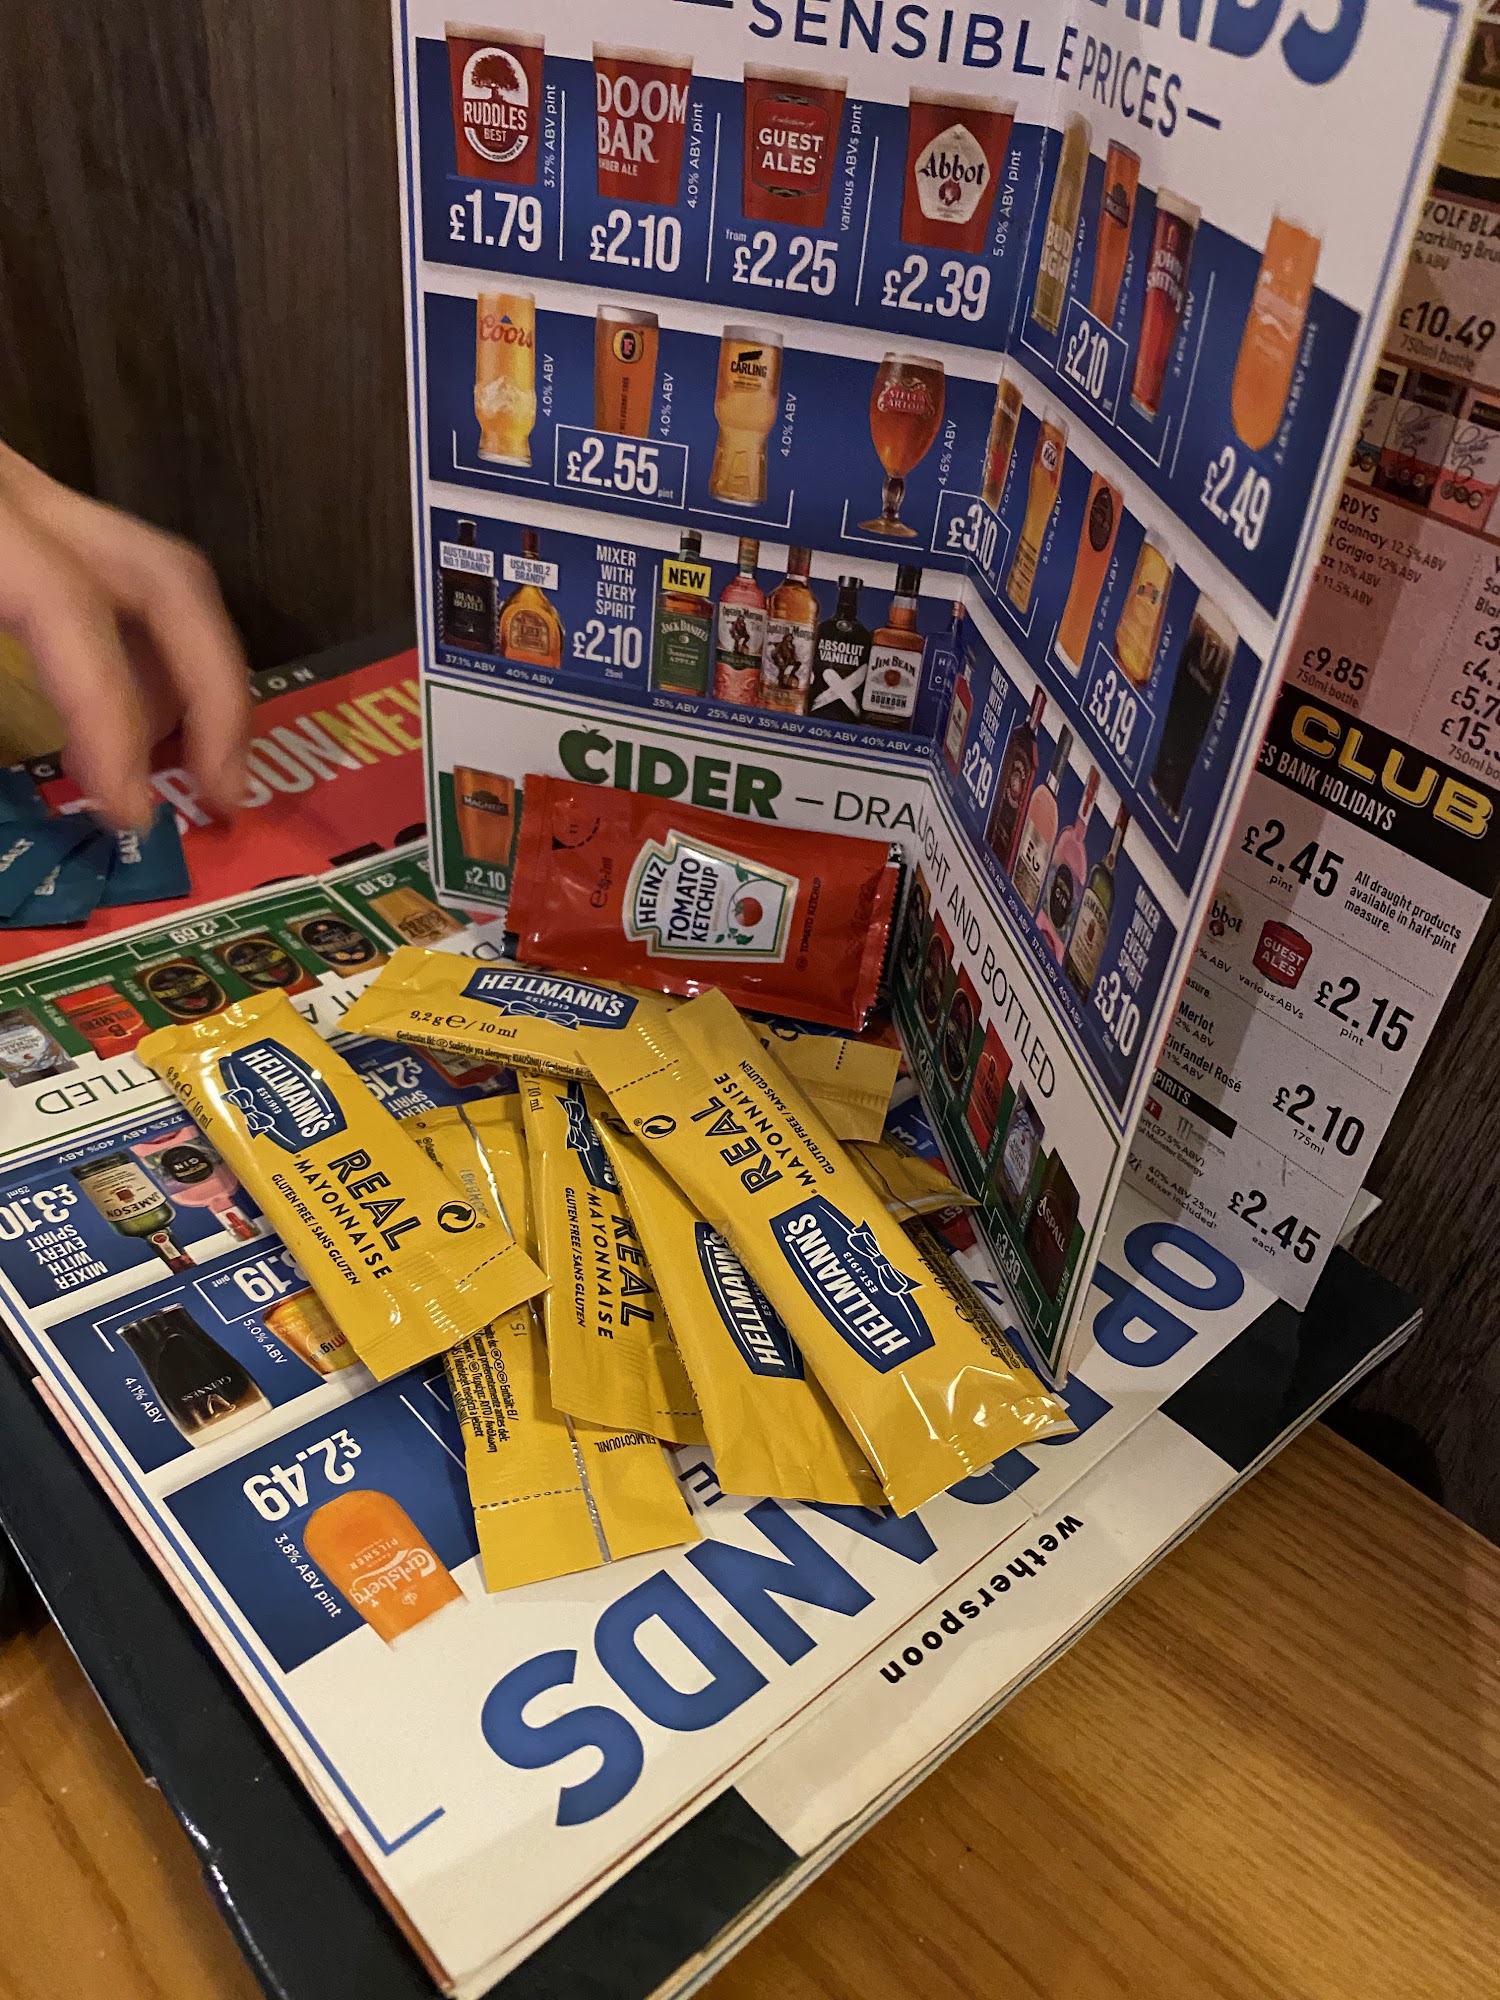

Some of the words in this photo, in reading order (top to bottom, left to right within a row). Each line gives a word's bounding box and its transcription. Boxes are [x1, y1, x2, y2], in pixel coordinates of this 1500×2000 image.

[748, 0, 1079, 83] SENSIBLE
[1078, 35, 1183, 138] PRICES
[546, 84, 557, 114] pint
[596, 72, 689, 124] DOOM
[463, 101, 527, 131] RUDDLES
[693, 102, 704, 133] pint
[851, 104, 863, 135] pint
[483, 129, 507, 143] BEST
[544, 118, 556, 152] ABV
[596, 116, 659, 164] BAR
[758, 127, 824, 153] GUEST
[689, 137, 701, 170] ABV
[760, 151, 817, 176] ALES
[843, 140, 858, 177] ABVs
[918, 151, 987, 186] Abbot
[1008, 150, 1022, 181] pint
[544, 156, 555, 188] 3.7%
[687, 173, 699, 208] 4.0%
[840, 180, 854, 231] various
[1001, 184, 1016, 218] ABV
[450, 189, 542, 252] £1.79
[725, 228, 747, 242] from
[589, 209, 682, 273] £2.10
[992, 220, 1009, 257] 5.0%
[732, 231, 839, 296] £2.25
[881, 254, 991, 321] £2.39
[479, 314, 533, 349] Coors
[1399, 301, 1496, 351] £10.49
[543, 354, 555, 383] ABV
[730, 361, 767, 379] CARLING
[1064, 320, 1109, 400] £2.10
[543, 386, 554, 417] 4.0%
[663, 373, 674, 401] ABV
[660, 406, 672, 436] 4.0%
[784, 393, 798, 423] ABV
[780, 424, 794, 457] 4.0%
[943, 420, 957, 451] ABV
[566, 437, 659, 495] £2.55
[938, 455, 952, 485] 4.6%
[1200, 446, 1272, 551] £2.49
[947, 504, 998, 571] £3.10
[1336, 536, 1375, 564] Grigio
[443, 545, 491, 564] AUSTRALIA'S
[460, 560, 490, 575] BRANDY
[510, 559, 531, 572] USA'S
[532, 564, 551, 576] NO.2
[596, 544, 637, 567] MIXER
[515, 571, 546, 586] BRANDY
[601, 563, 634, 584] WITH
[668, 567, 706, 589] NEW
[596, 581, 637, 603] EVERY
[595, 600, 637, 621] SPIRIT
[660, 620, 680, 634] JACK
[573, 619, 643, 669] £2.10
[818, 638, 864, 656] ABSOLUT
[819, 652, 860, 668] VANILIA
[473, 659, 496, 672] ABV
[506, 668, 529, 680] 40%
[531, 673, 554, 685] ABV
[871, 656, 890, 670] JIM
[891, 657, 916, 676] BEAM
[1296, 669, 1328, 692] 750ml
[1303, 647, 1368, 691] £9.85
[652, 698, 674, 710] 35%
[676, 702, 700, 714] ABV
[708, 708, 729, 720] 25%
[730, 712, 755, 725] ABV
[870, 693, 907, 708] BOURBON
[1088, 669, 1137, 755] £3.19
[758, 718, 780, 730] 35%
[781, 721, 805, 734] ABV
[808, 727, 832, 740] 40%
[834, 731, 858, 743] ABV
[861, 736, 885, 748] 40%
[887, 740, 912, 752] ABV
[963, 741, 994, 809] £2.19
[1291, 705, 1494, 840] CLUB
[1278, 750, 1321, 791] BANK
[1319, 774, 1397, 832] HOLIDAYS
[1241, 818, 1344, 898] £2.45
[638, 860, 668, 925] HEINZ
[1269, 874, 1294, 894] pint
[558, 725, 784, 820] CIDER
[833, 790, 951, 894] DRAUGHT
[947, 885, 981, 956] AND
[980, 944, 1056, 1099] BOTTLED
[666, 856, 702, 945] TOMATO
[688, 866, 720, 944] KETCHUP
[1355, 871, 1369, 884] All
[1368, 876, 1411, 909] draught
[1411, 902, 1462, 940] products
[1343, 899, 1391, 935] measure.
[1349, 885, 1396, 918] available
[1396, 909, 1407, 924] in
[1405, 915, 1458, 956] half-pint
[1260, 952, 1298, 979] ALES
[1263, 936, 1305, 967] GUEST
[478, 972, 625, 1018] HELLMANN'S
[525, 993, 570, 1011] EST.1913
[1238, 973, 1276, 1005] various
[1275, 996, 1305, 1020] ABVs
[478, 1021, 496, 1034] 10
[1093, 970, 1141, 1057] £3.10
[1178, 1000, 1215, 1035] Merlot
[1313, 975, 1415, 1053] £2.15
[1191, 1029, 1215, 1048] ABV
[1338, 1026, 1365, 1047] pint
[737, 1059, 769, 1093] GLUTEN
[1180, 1062, 1204, 1081] ABV
[1213, 1065, 1243, 1094] Rosé
[240, 1045, 332, 1139] HELLMANN'S
[256, 1085, 285, 1116] EST.1913
[388, 1089, 428, 1113] SPIRIT
[763, 1088, 787, 1113] SANS
[713, 1072, 817, 1187] MAYONNAISE
[786, 1116, 809, 1145] FREE
[1272, 1084, 1366, 1157] £2.10
[57, 1146, 84, 1163] ABV
[87, 1138, 115, 1153] 40%
[690, 1094, 784, 1195] REAL
[1292, 1128, 1325, 1156] 175ml
[173, 1158, 201, 1172] GIN
[802, 1141, 836, 1176] GLUTEN
[106, 1191, 162, 1217] JAMESON
[328, 1147, 422, 1252] REAL
[565, 1187, 579, 1223] GLUTEN
[270, 1172, 302, 1206] GLUTEN
[294, 1202, 315, 1229] FREE
[311, 1224, 336, 1252] SANS
[328, 1246, 362, 1286] GLUTEN
[292, 1157, 393, 1280] MAYONNAISE
[1037, 1196, 1066, 1253] ASPALL
[1227, 1189, 1322, 1264] £2.45
[29, 1223, 79, 1254] SPIRIT
[38, 1239, 88, 1265] EVERY
[570, 1224, 581, 1248] FREE
[1252, 1235, 1277, 1257] each
[47, 1250, 93, 1274] WITH
[55, 1259, 109, 1292] MIXER
[573, 1254, 583, 1281] SANS
[587, 1192, 613, 1339] MAYONNAISE
[610, 1214, 655, 1327] REAL
[842, 1252, 879, 1294] EST.1913
[211, 1274, 230, 1288] pint
[783, 1211, 912, 1357] HELLMANN'S
[575, 1284, 586, 1327] GLUTEN
[697, 1232, 787, 1371] HELLMANN'S
[242, 1318, 268, 1344] 5.0%
[262, 1340, 288, 1365] ABV
[125, 1375, 145, 1401] 4.1%
[139, 1399, 165, 1425] ABV
[181, 1375, 232, 1403] GUINNESS
[242, 1428, 363, 1523] £2.49
[349, 1537, 399, 1570] PILSNER
[274, 1532, 303, 1563] 3.8%
[296, 1563, 324, 1591] ABV
[314, 1588, 343, 1618] pint
[349, 1547, 437, 1609] Carlsberg
[879, 1511, 1087, 1687] wetherspoon
